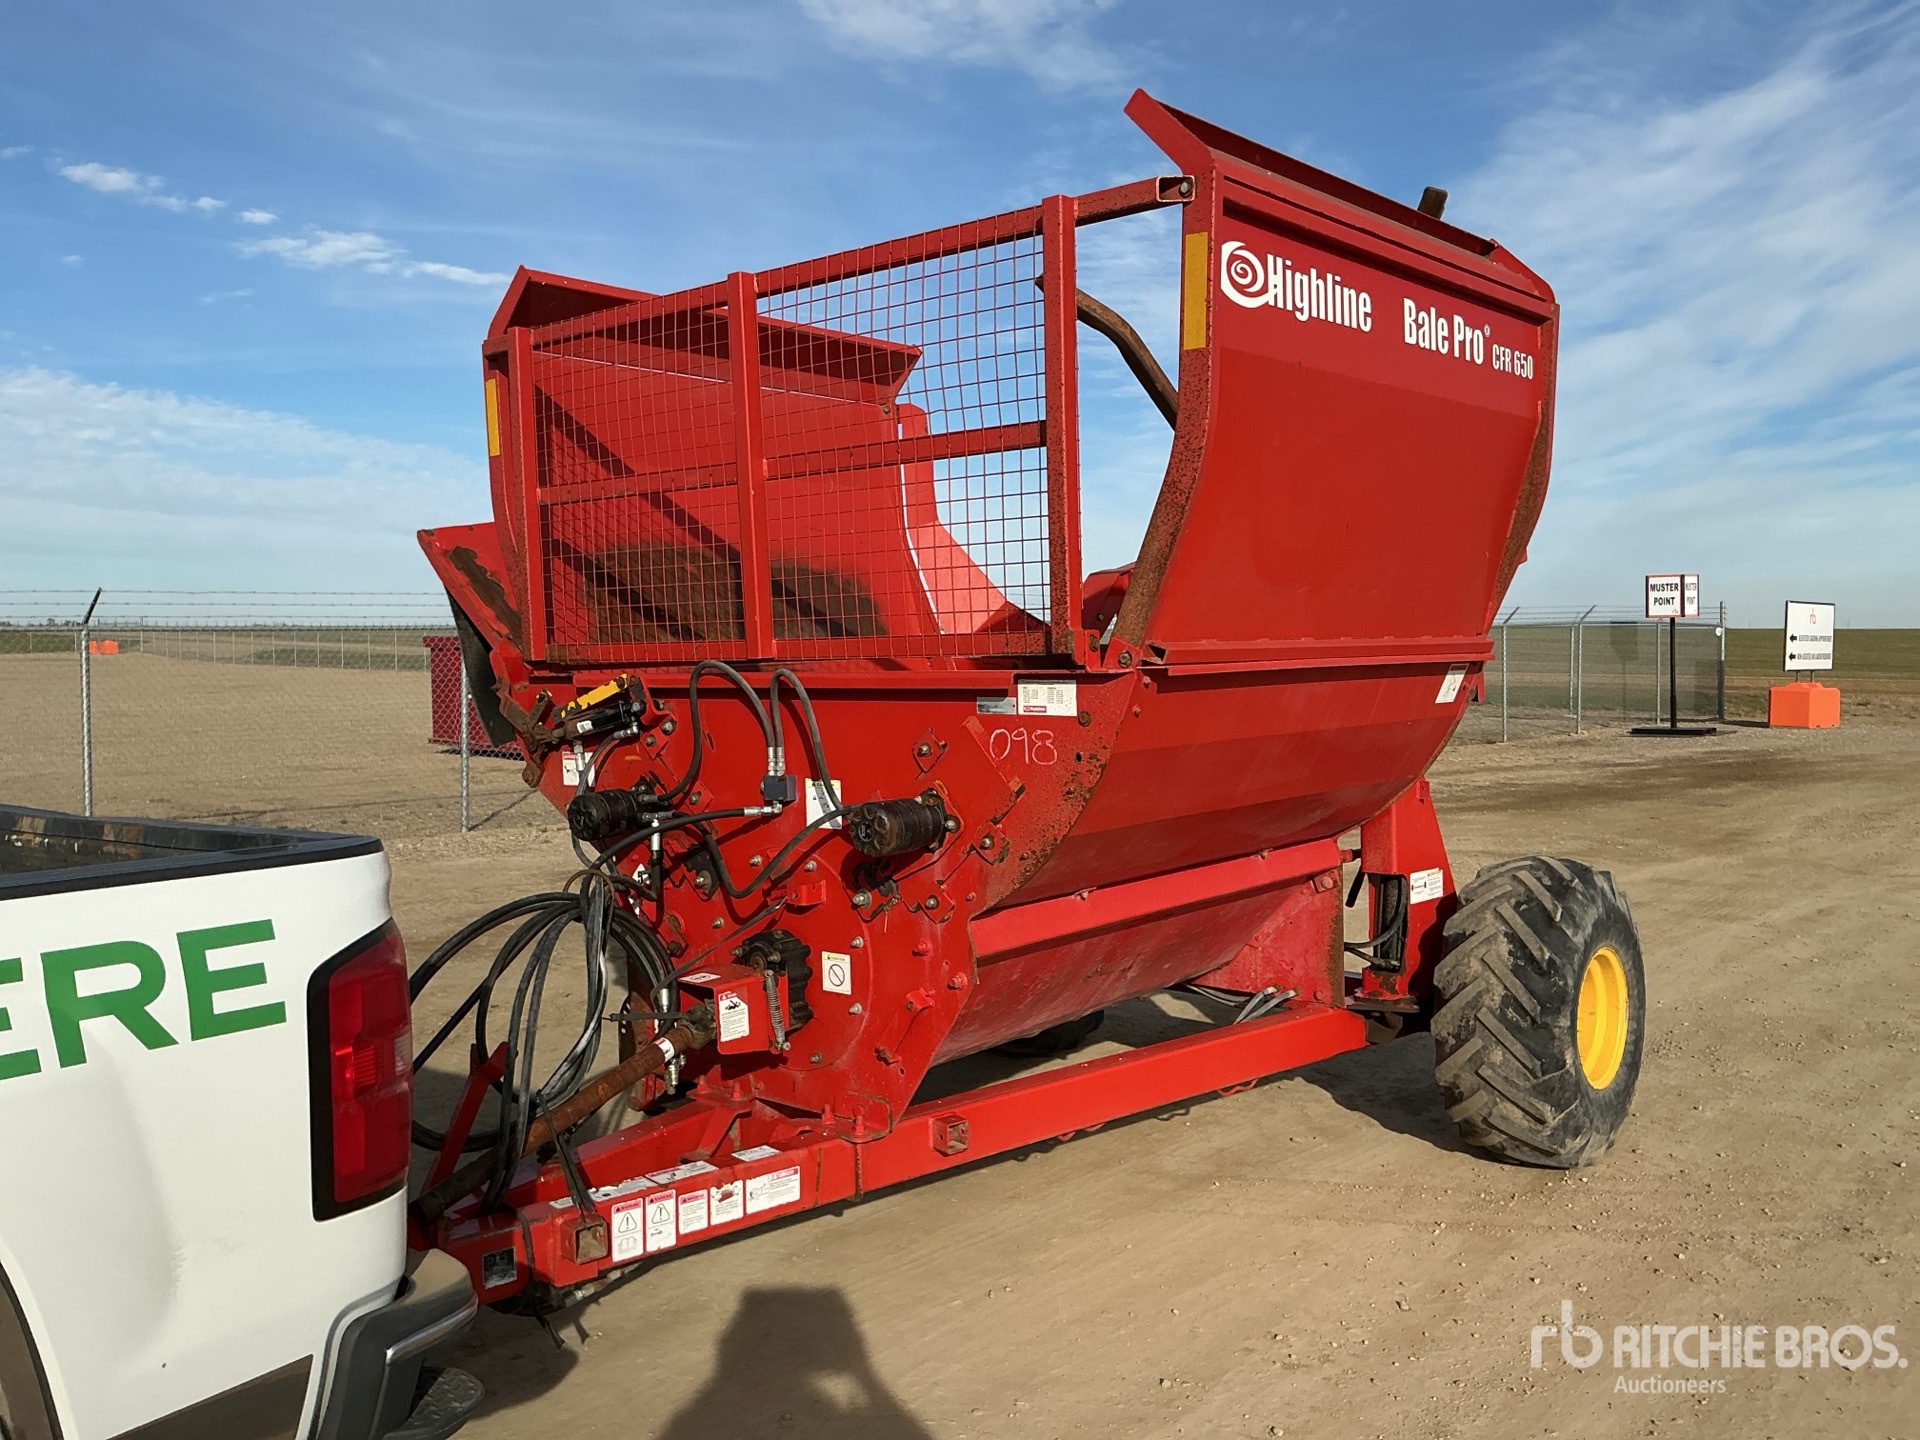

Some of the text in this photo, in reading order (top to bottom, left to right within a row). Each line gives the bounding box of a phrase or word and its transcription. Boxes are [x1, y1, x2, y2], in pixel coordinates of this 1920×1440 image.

[1267, 253, 1372, 332] Highline
[1403, 298, 1449, 354] Bale
[1492, 343, 1512, 373] CFR
[1513, 350, 1533, 380] 650
[1650, 583, 1679, 592] MUSTER
[1653, 596, 1675, 606] POINT
[989, 727, 1058, 766] 098
